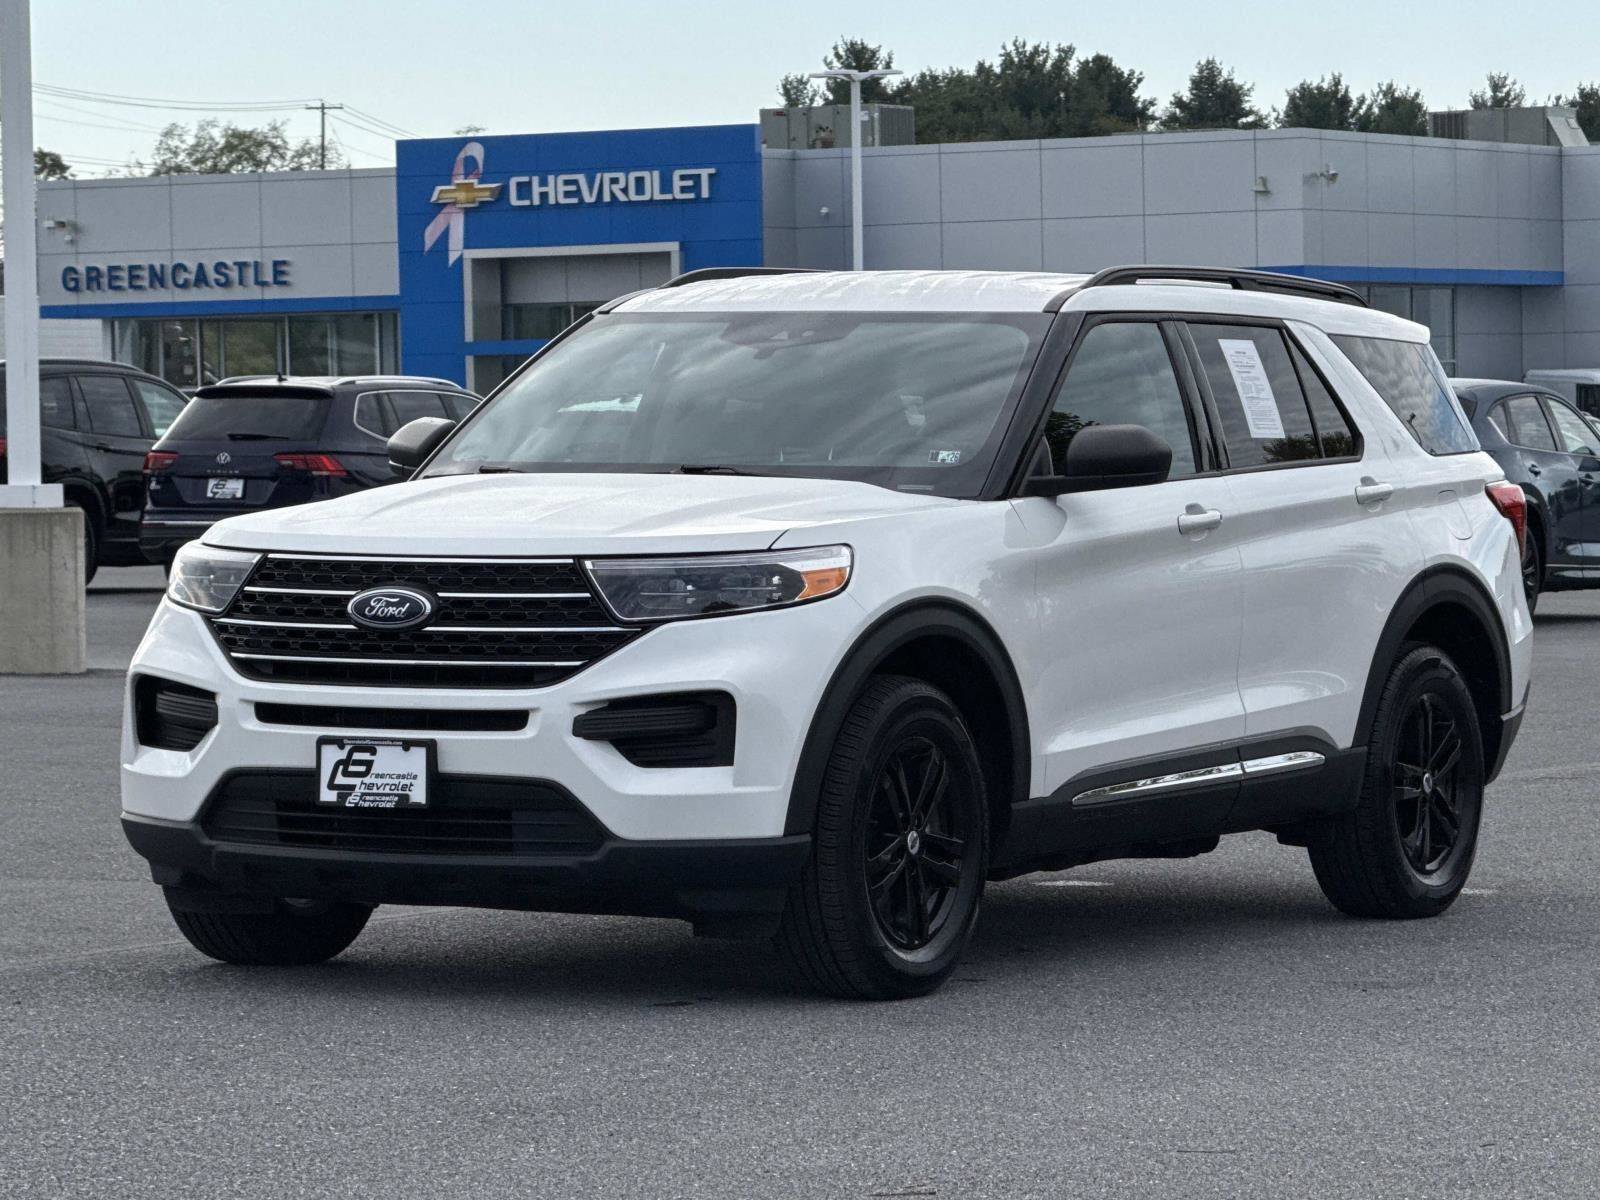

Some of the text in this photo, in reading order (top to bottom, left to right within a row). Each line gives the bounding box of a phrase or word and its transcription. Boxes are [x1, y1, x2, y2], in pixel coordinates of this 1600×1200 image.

[509, 167, 717, 207] CHEVROLET
[61, 259, 292, 293] GREENCASTLE
[364, 596, 410, 618] Ford
